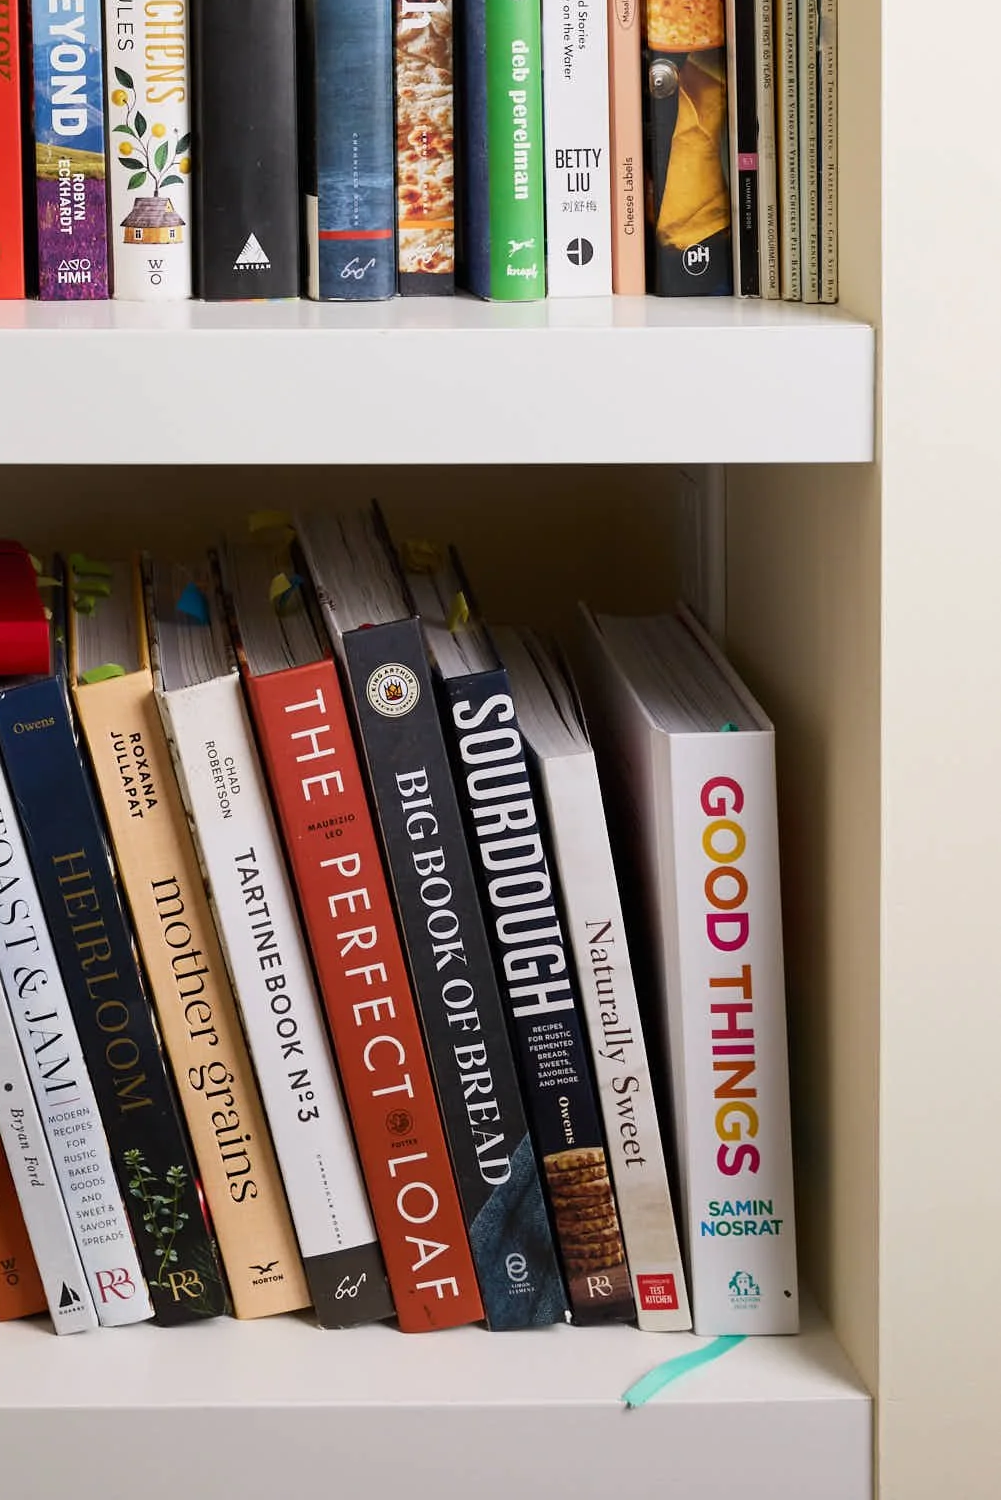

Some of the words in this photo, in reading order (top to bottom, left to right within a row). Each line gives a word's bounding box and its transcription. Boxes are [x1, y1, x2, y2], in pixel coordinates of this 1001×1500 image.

[511, 40, 529, 82] deb
[578, 11, 588, 49] Stories
[508, 90, 530, 200] perelman
[555, 148, 601, 169] BETTY
[567, 173, 590, 192] LIU
[13, 715, 56, 735] Owens
[110, 731, 144, 819] JULLAPAT
[129, 731, 158, 810] ROXANA
[395, 766, 441, 841] BIG
[451, 693, 575, 1018] SOURDOUGH
[700, 776, 750, 952] GOOD
[412, 846, 469, 972] BOOK
[13, 966, 49, 1000] &
[52, 847, 154, 1113] HEIRLOOM
[234, 846, 283, 971] TARTINE
[265, 975, 305, 1060] BOOK
[284, 688, 345, 802] THE
[320, 852, 415, 1099] PERFECT
[388, 1152, 460, 1299] LOAF
[151, 875, 220, 1046] mother
[188, 1060, 258, 1204] grains
[441, 977, 481, 1032] OF
[585, 918, 634, 1065] Naturally
[611, 1076, 647, 1169] Sweet
[24, 1011, 78, 1095] JAM
[709, 964, 761, 1176] THINGS
[454, 1039, 512, 1187] BREAD
[558, 1095, 575, 1145] Owens
[700, 1219, 784, 1237] NOSRAT
[708, 1200, 774, 1216] SAMIN
